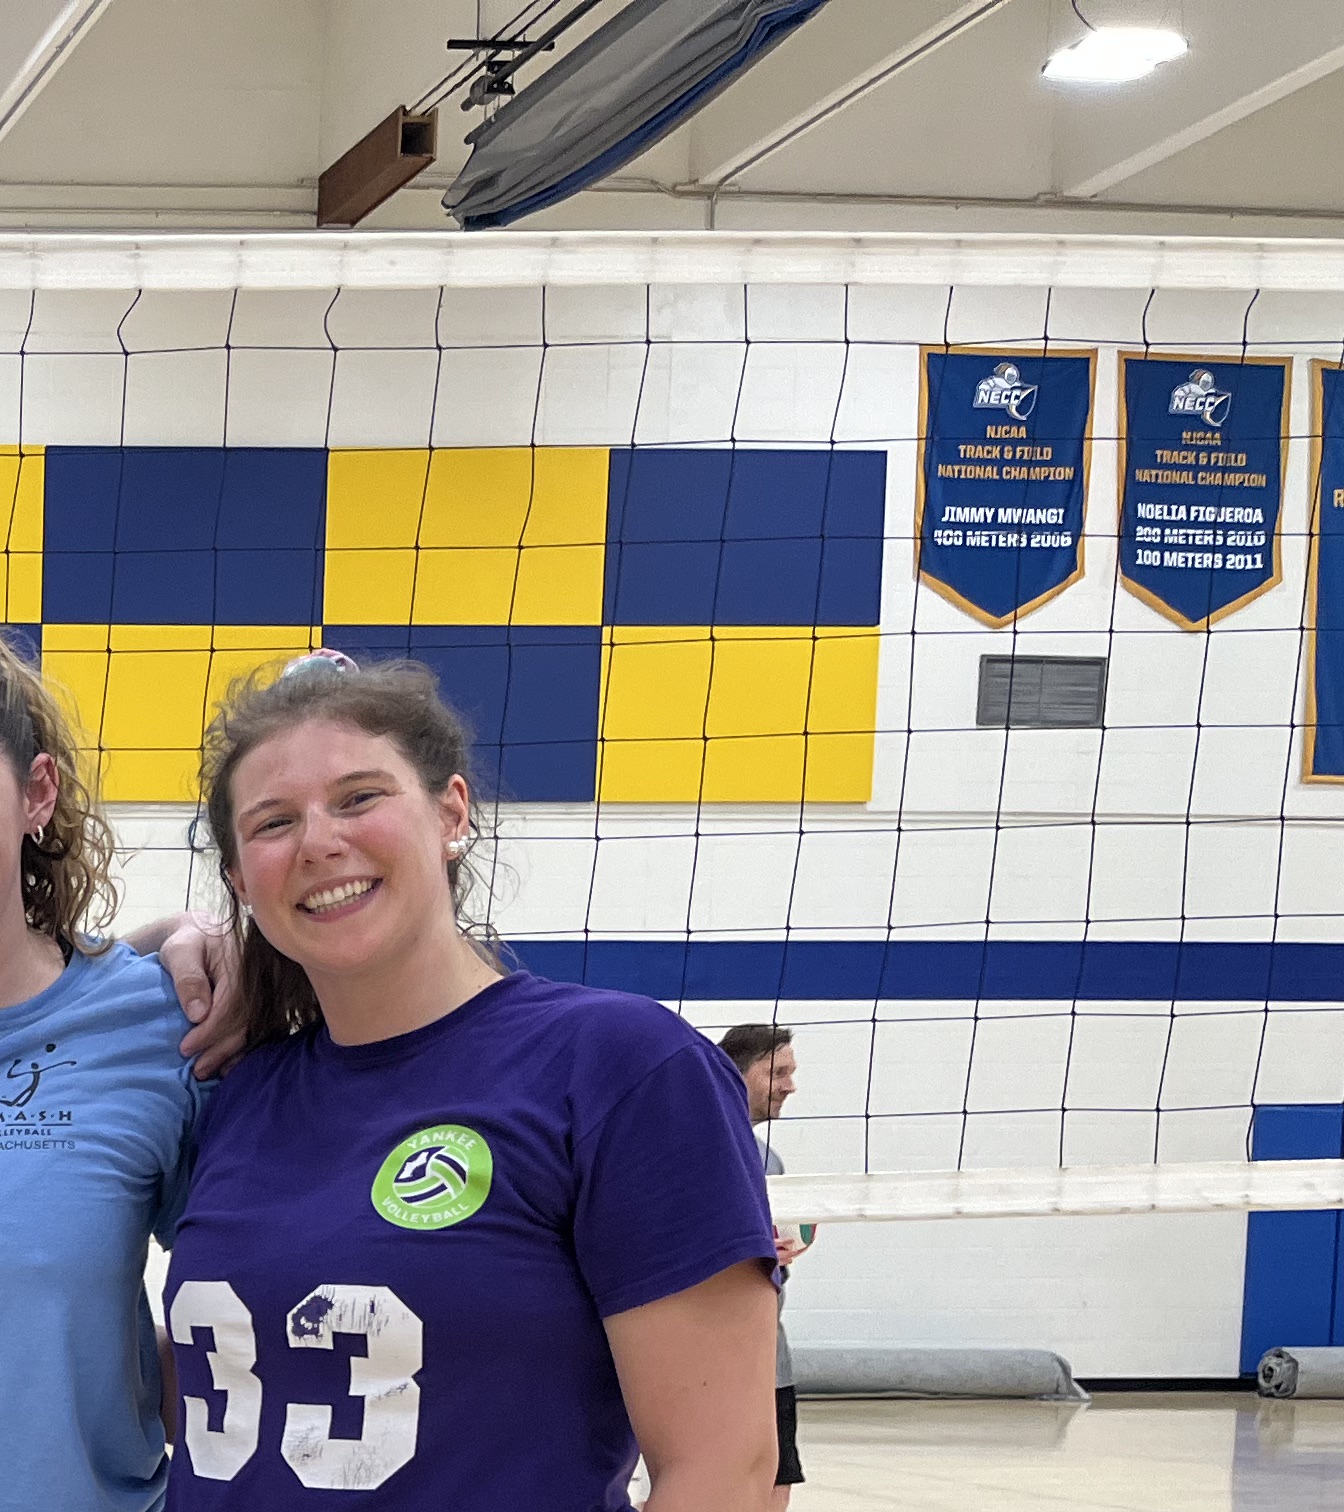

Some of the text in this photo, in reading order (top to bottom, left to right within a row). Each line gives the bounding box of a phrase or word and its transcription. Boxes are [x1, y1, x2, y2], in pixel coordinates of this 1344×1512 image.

[977, 389, 1021, 404] NECC
[1172, 395, 1215, 411] NECC
[986, 425, 1027, 439] NJCAA
[1181, 430, 1222, 446] NJCAA
[958, 445, 1000, 459] TRACK
[1155, 450, 1196, 464] TRACK
[938, 463, 1075, 480] NATIONAL CHAMPION
[1135, 468, 1266, 487] NATIONAL CHAMPION
[941, 505, 1065, 525] JIMMY MWANGI
[1137, 502, 1187, 521] NOELIA
[1164, 527, 1223, 546] METERS
[1135, 548, 1264, 570] 100 METERS 2011
[407, 1130, 476, 1150] YANKEE
[381, 1196, 470, 1224] VOLLEYBALL
[169, 1280, 424, 1490] 33
